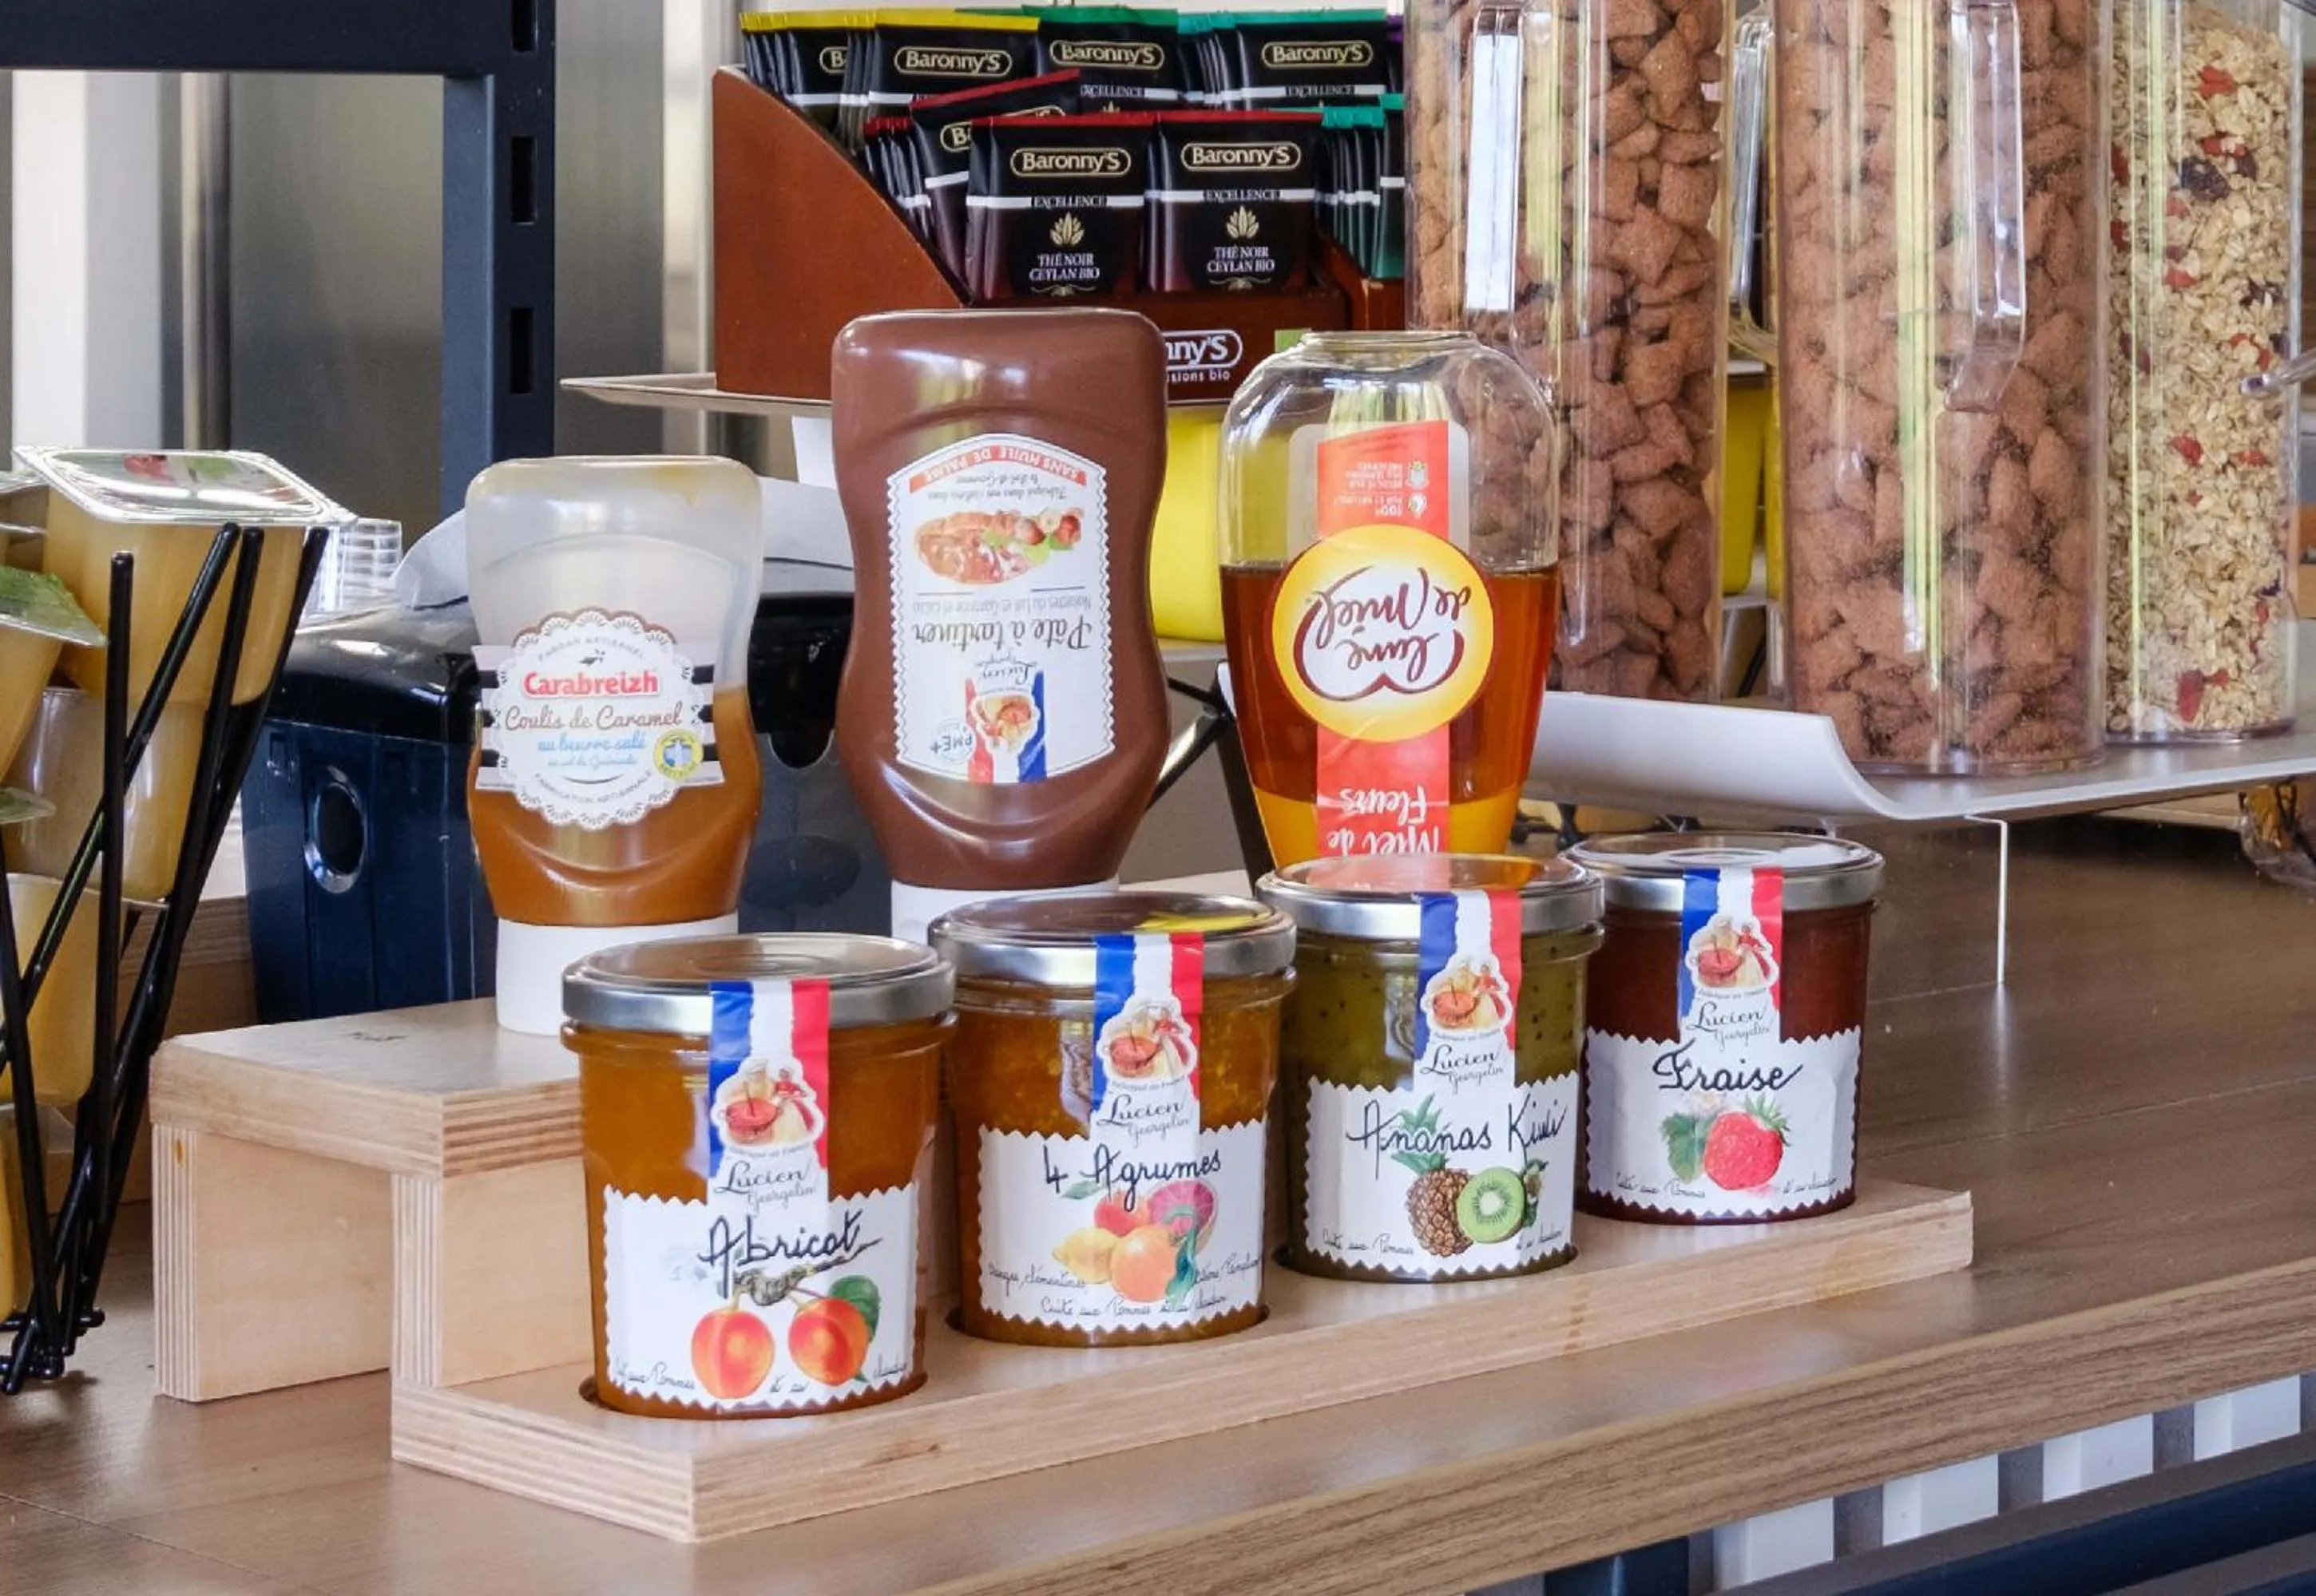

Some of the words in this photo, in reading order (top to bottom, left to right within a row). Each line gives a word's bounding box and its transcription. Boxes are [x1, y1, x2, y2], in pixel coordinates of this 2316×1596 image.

[1033, 195, 1108, 210] EXCELLENCE
[1206, 189, 1278, 204] EXCELLENCE
[1064, 251, 1095, 266] NOIR
[1207, 260, 1254, 273] CEYLAN
[1255, 259, 1275, 272] BIO
[1240, 246, 1269, 258] NOIR
[1029, 267, 1077, 282] CEYLAN
[1078, 267, 1100, 279] BIO
[1209, 368, 1231, 381] bio
[926, 453, 969, 481] PALME
[974, 447, 992, 462] DE
[999, 446, 1039, 466] HUILE
[1042, 455, 1078, 479] SANS
[1432, 584, 1472, 621] de
[912, 620, 1003, 651] tartiner
[1012, 620, 1025, 647] à
[1033, 616, 1093, 650] Pâte
[523, 670, 659, 696] Carabreizh
[983, 661, 1038, 686] Lucien
[505, 705, 563, 731] Coulis
[569, 705, 592, 730] de
[595, 701, 683, 731] Caramel
[1339, 784, 1427, 826] Fleurs
[1326, 828, 1355, 859] de
[1685, 1000, 1768, 1032] Lucien
[1420, 1043, 1502, 1075] Lucien
[1652, 1038, 1803, 1092] Fraise
[1097, 1092, 1188, 1126] Lucien
[1346, 1099, 1492, 1179] Ananas
[1507, 1094, 1568, 1166] Kiwi
[713, 1158, 813, 1195] Lucien
[1042, 1145, 1069, 1194] 4
[1078, 1143, 1223, 1212] Agrumes
[698, 1208, 883, 1300] Abricot
